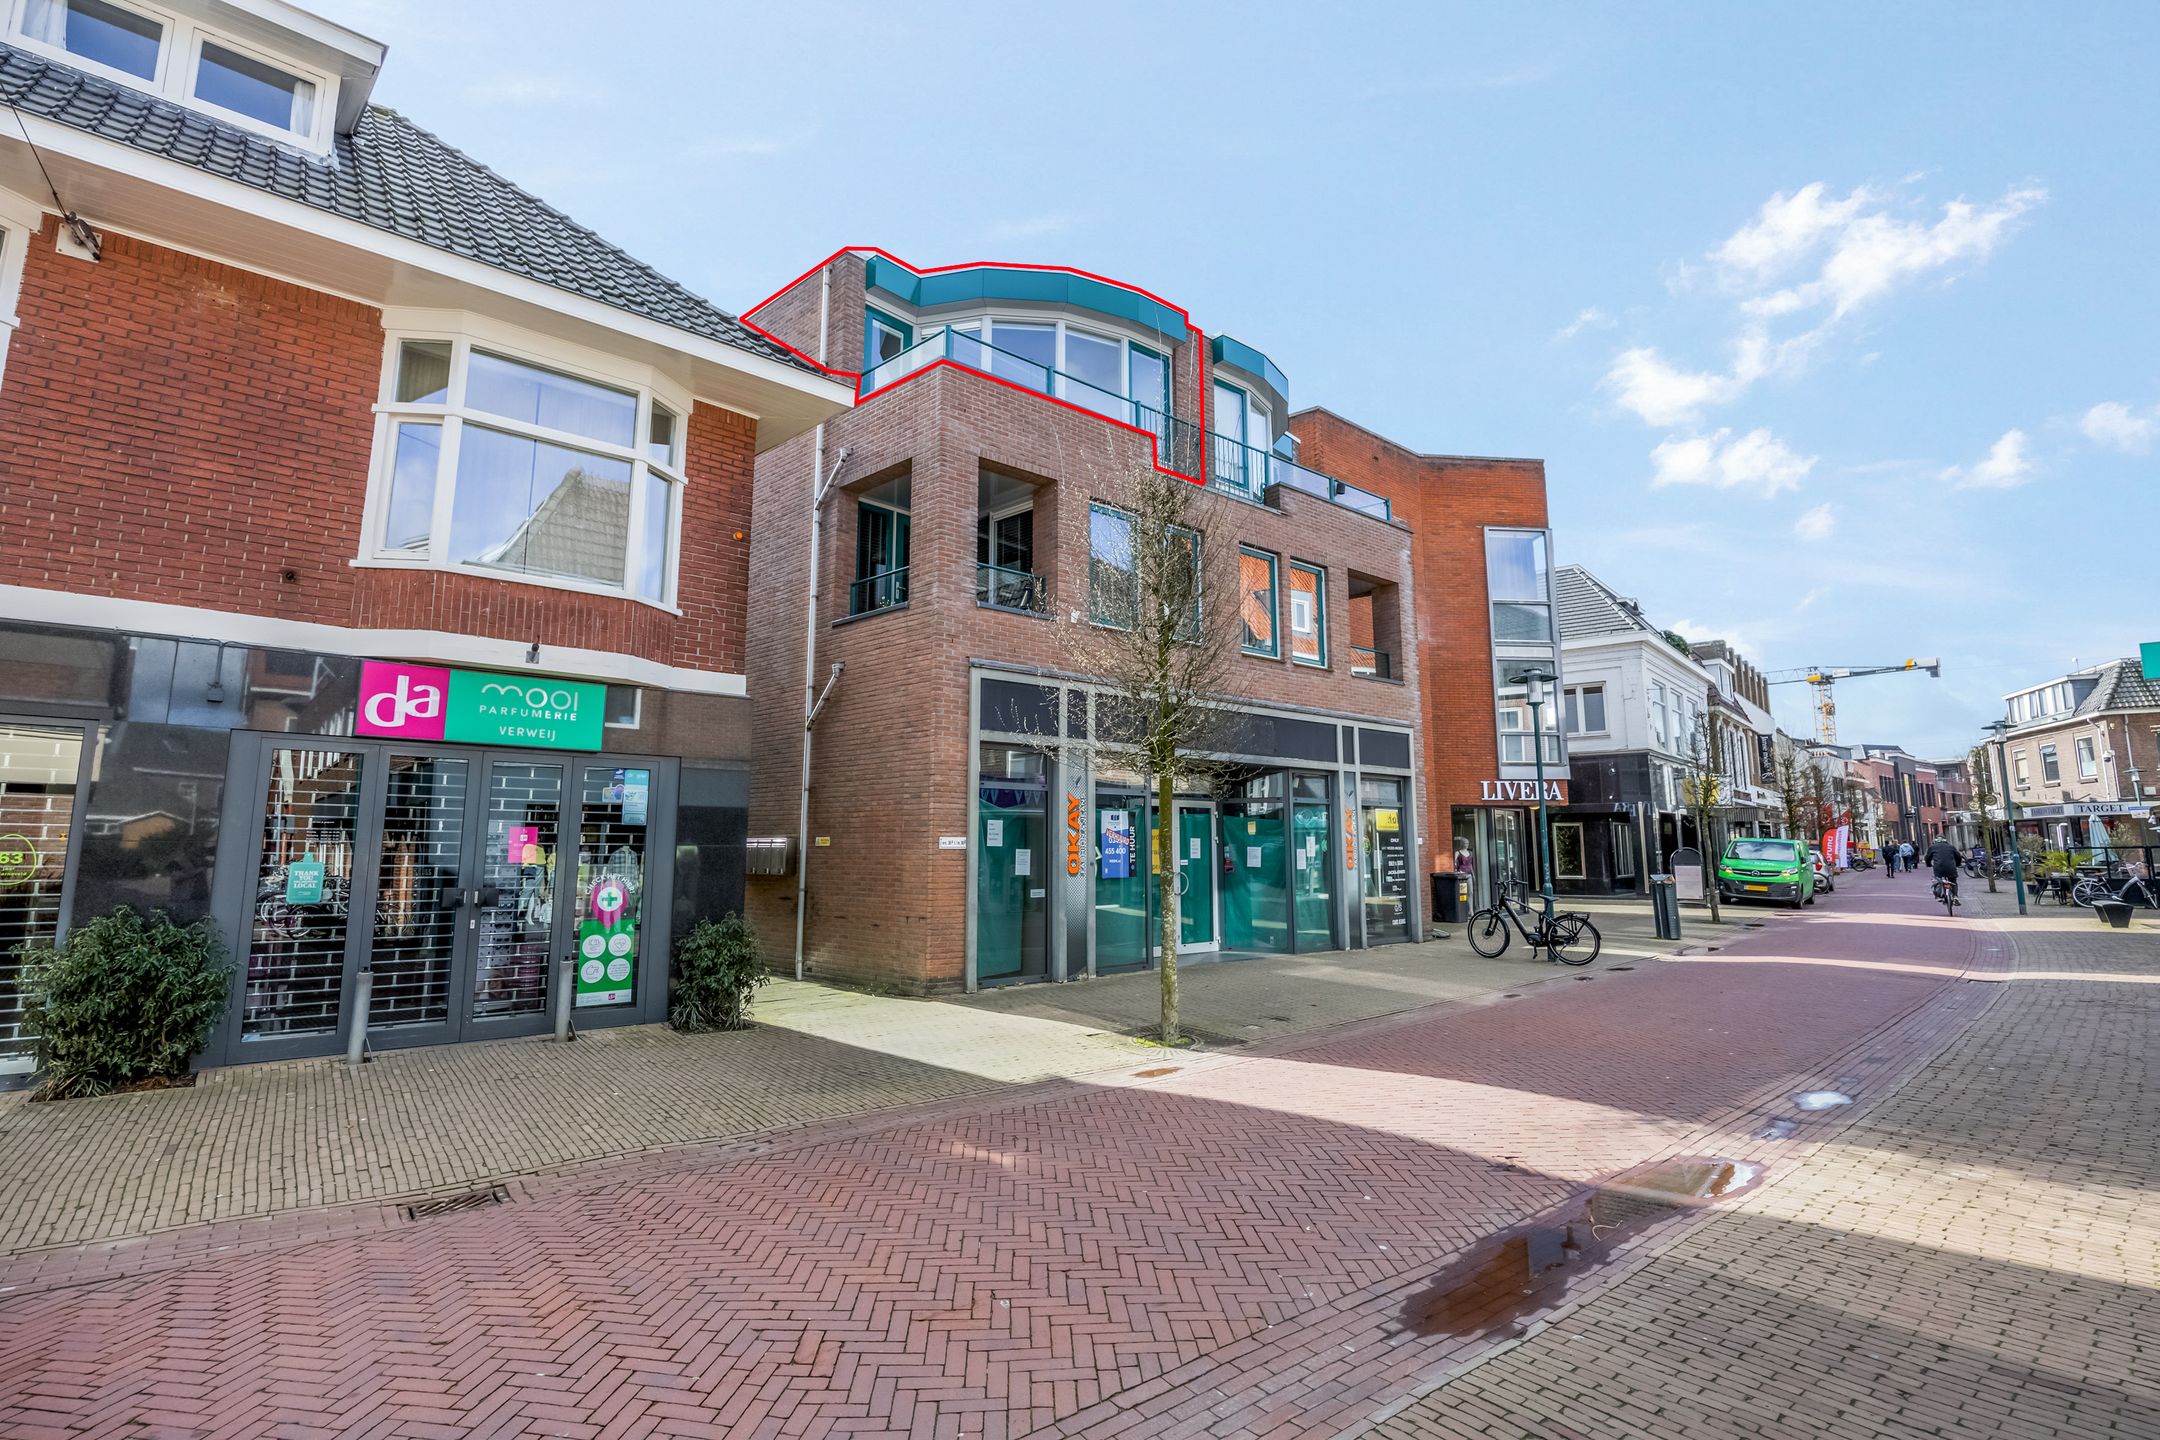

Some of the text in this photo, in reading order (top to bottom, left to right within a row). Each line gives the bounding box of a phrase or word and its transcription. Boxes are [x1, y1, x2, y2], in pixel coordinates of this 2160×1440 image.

[364, 674, 441, 728] da
[481, 682, 578, 711] mooi
[479, 704, 577, 721] PARFUMERIE
[499, 725, 556, 742] VERWEIJ
[2077, 804, 2124, 813] TARGET
[1067, 792, 1081, 875] OKAY
[1343, 804, 1355, 870] OKAY
[1105, 847, 1115, 855] 455
[1129, 852, 1136, 864] TE
[585, 875, 607, 895] CHECK
